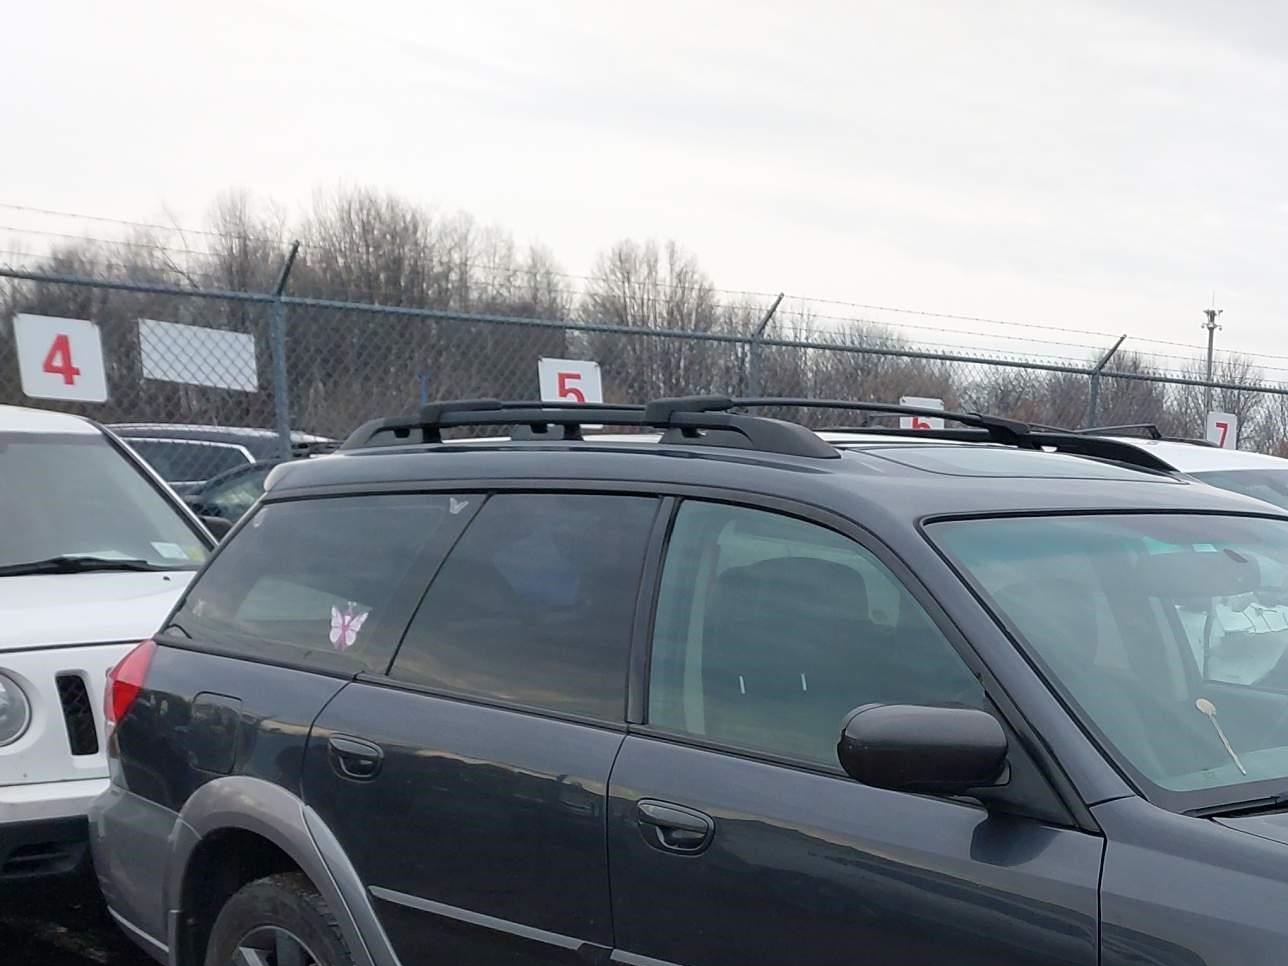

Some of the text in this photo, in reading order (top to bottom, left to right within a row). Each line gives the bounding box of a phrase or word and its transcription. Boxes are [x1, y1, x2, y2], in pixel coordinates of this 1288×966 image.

[43, 334, 81, 385] 4
[558, 373, 585, 404] 5
[1215, 421, 1228, 449] 7
